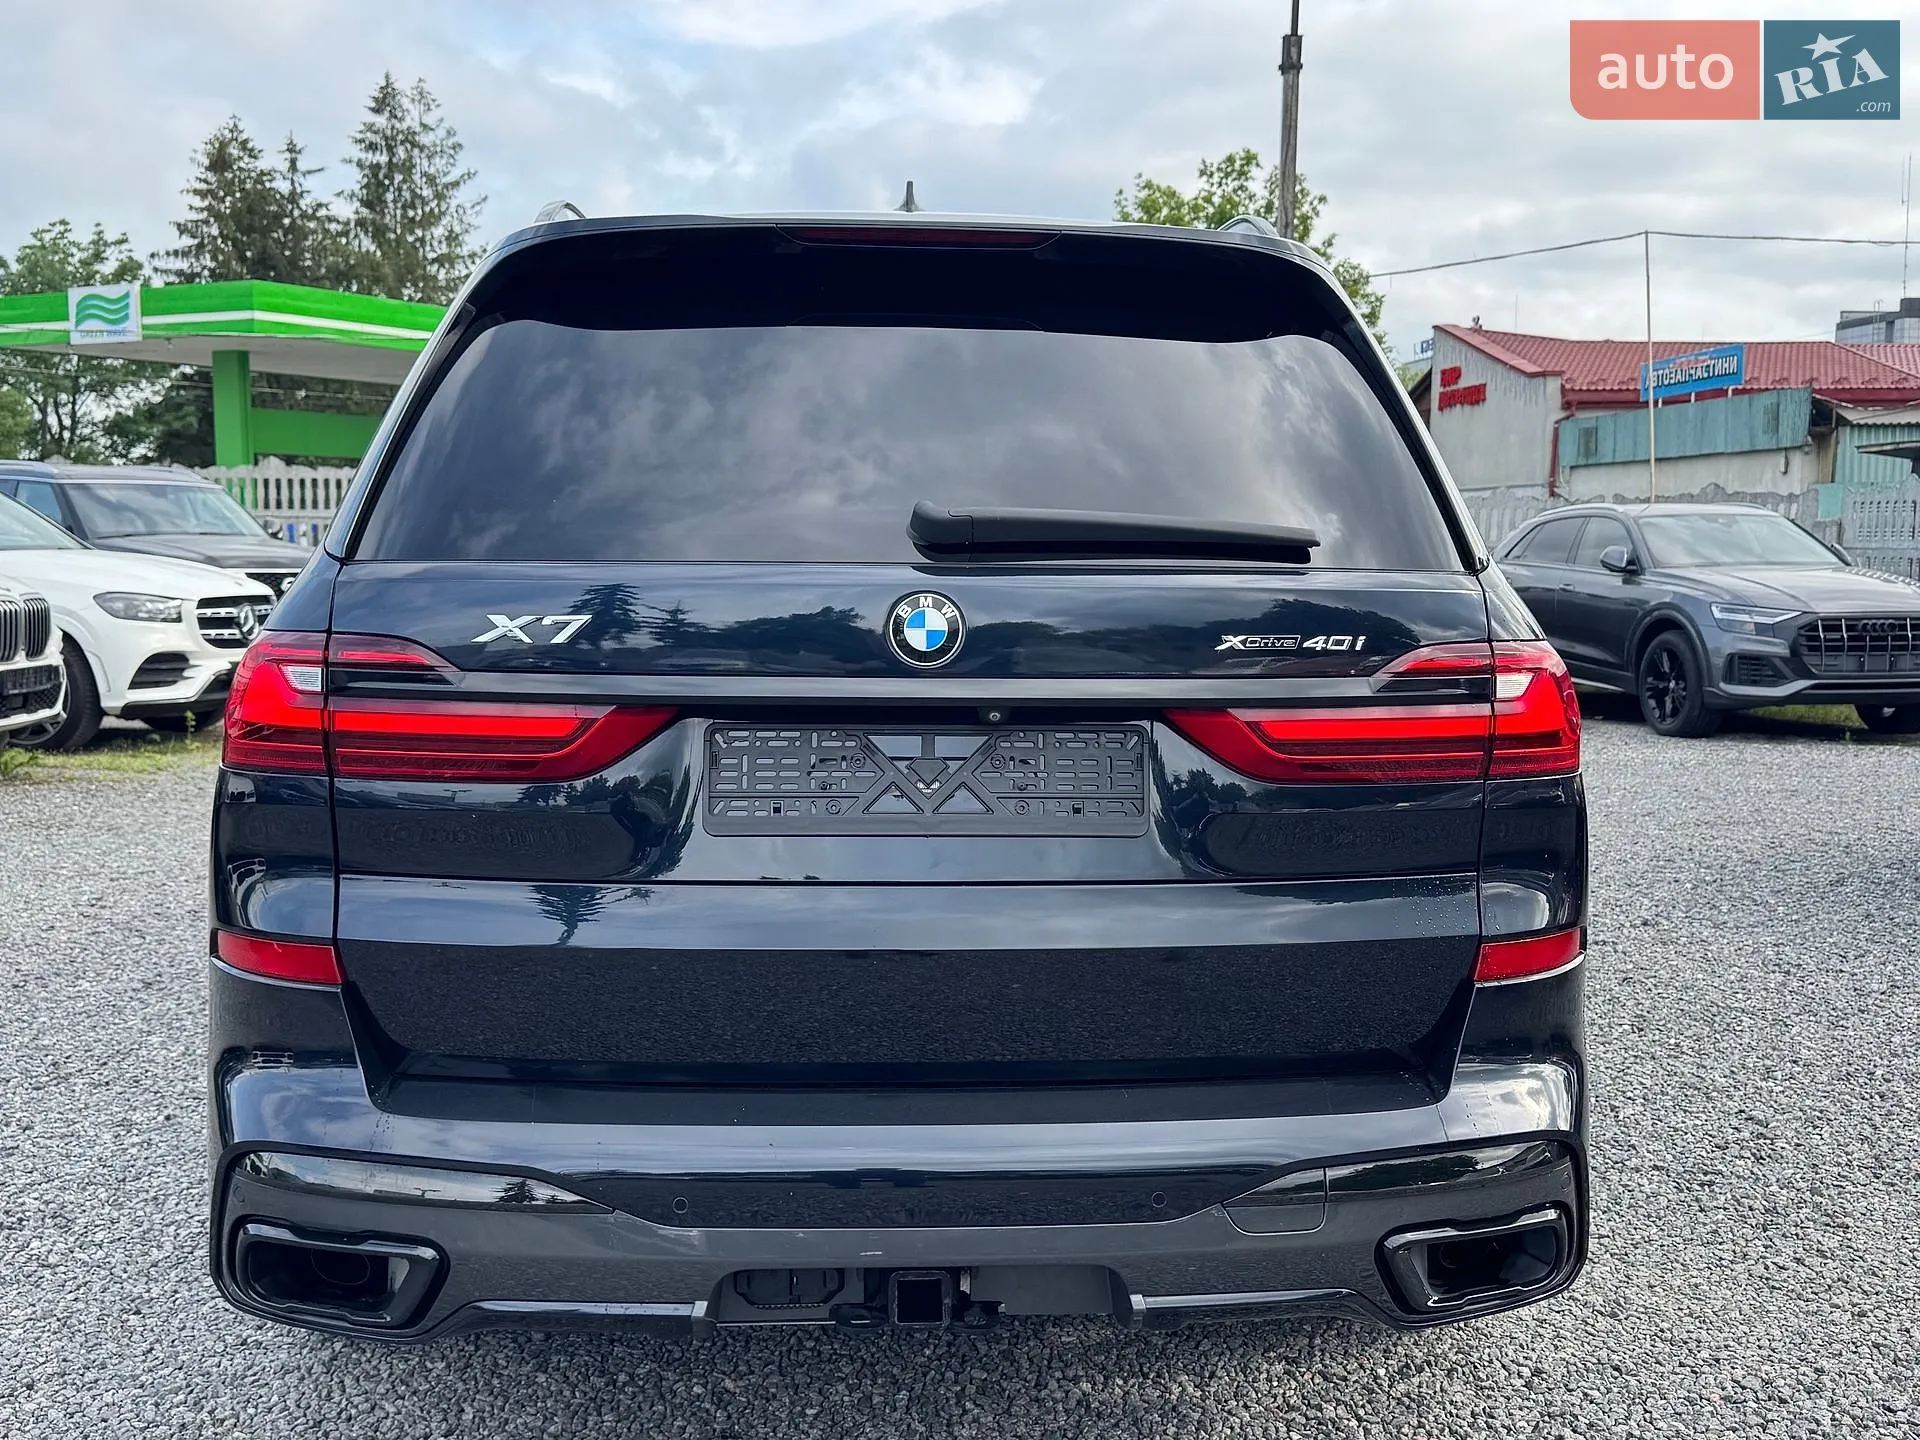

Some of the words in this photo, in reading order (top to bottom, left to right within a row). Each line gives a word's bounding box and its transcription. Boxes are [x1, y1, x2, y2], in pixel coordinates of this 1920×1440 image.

[897, 596, 956, 619] BMW
[471, 614, 593, 644] X7
[1302, 635, 1367, 651] 40i
